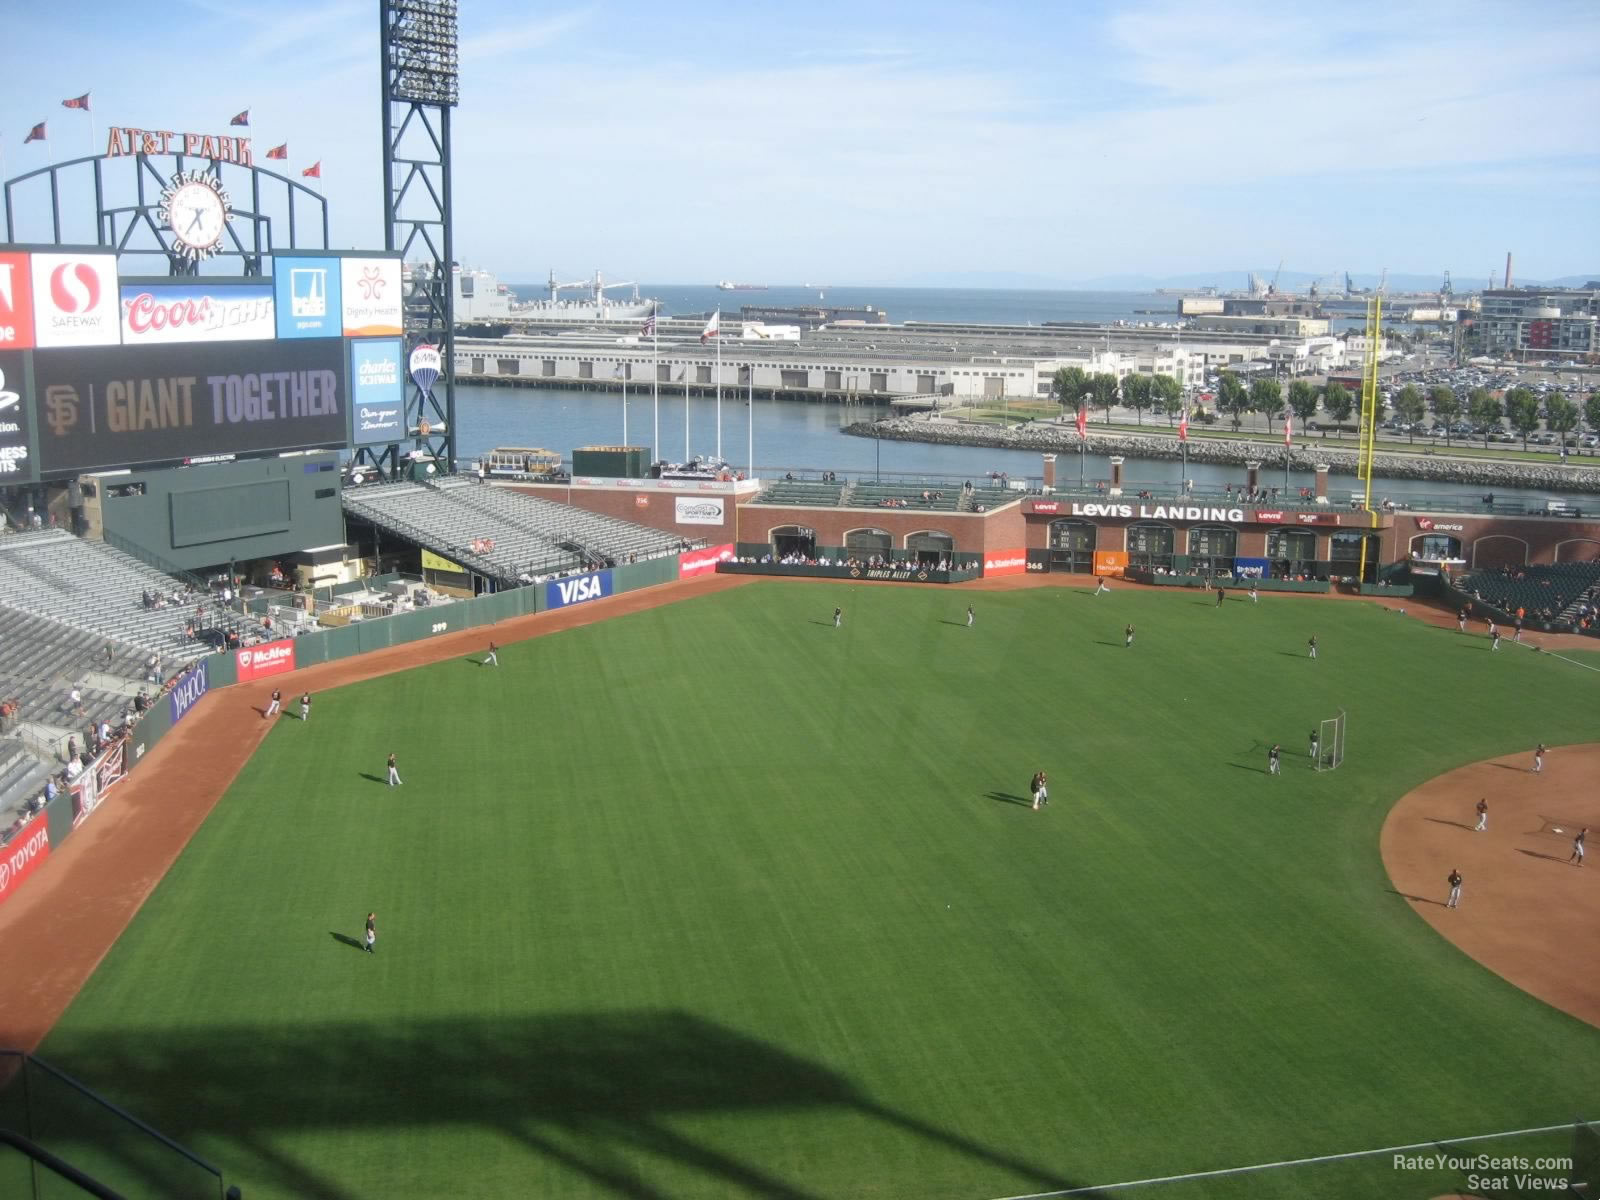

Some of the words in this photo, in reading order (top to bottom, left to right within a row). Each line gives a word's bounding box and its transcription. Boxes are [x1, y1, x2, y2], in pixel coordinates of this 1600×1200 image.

[107, 127, 174, 158] AT&T
[183, 132, 254, 167] PARK
[159, 185, 176, 221] SAN
[171, 169, 236, 222] FRANCISCO
[173, 238, 225, 261] GIANTS
[125, 293, 210, 334] Coors
[346, 307, 373, 318] Dignity
[375, 307, 398, 316] Health
[52, 316, 102, 328] SAFEWAY
[360, 358, 397, 374] charles
[360, 374, 397, 385] SCHWAB
[105, 376, 197, 433] GIANT
[207, 369, 339, 425] TOGETHER
[1140, 505, 1244, 522] LANDING
[1433, 523, 1463, 531] america
[867, 569, 890, 577] TRIPLES
[892, 571, 911, 579] ALLEY
[1026, 562, 1043, 570] 365
[556, 575, 602, 604] VISA
[432, 622, 448, 632] 399
[253, 646, 292, 663] McAfee
[173, 664, 206, 720] YAHOO!
[10, 826, 49, 876] TOYOTA
